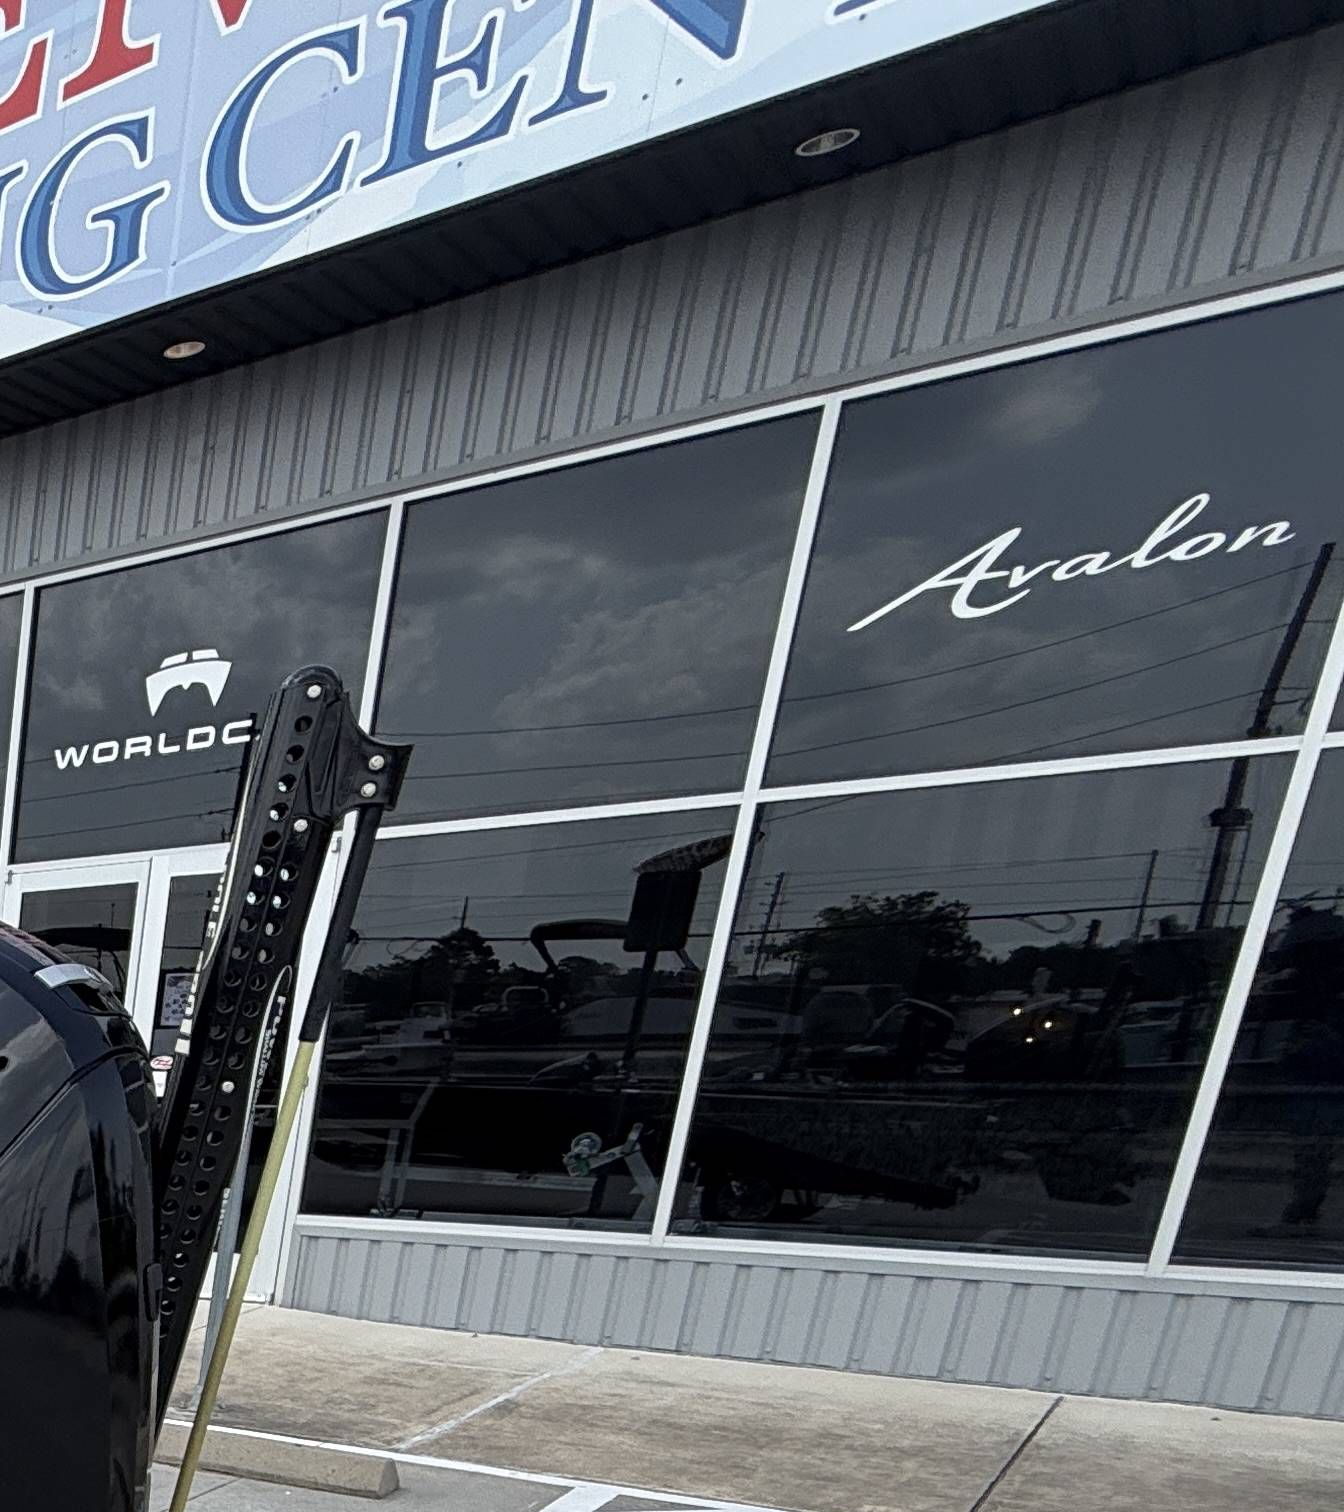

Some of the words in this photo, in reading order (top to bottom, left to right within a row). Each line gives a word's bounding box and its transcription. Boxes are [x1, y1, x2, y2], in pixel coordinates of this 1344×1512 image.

[205, 0, 888, 226] CEN
[846, 492, 1295, 632] Avalon
[54, 719, 258, 770] WORLDC
